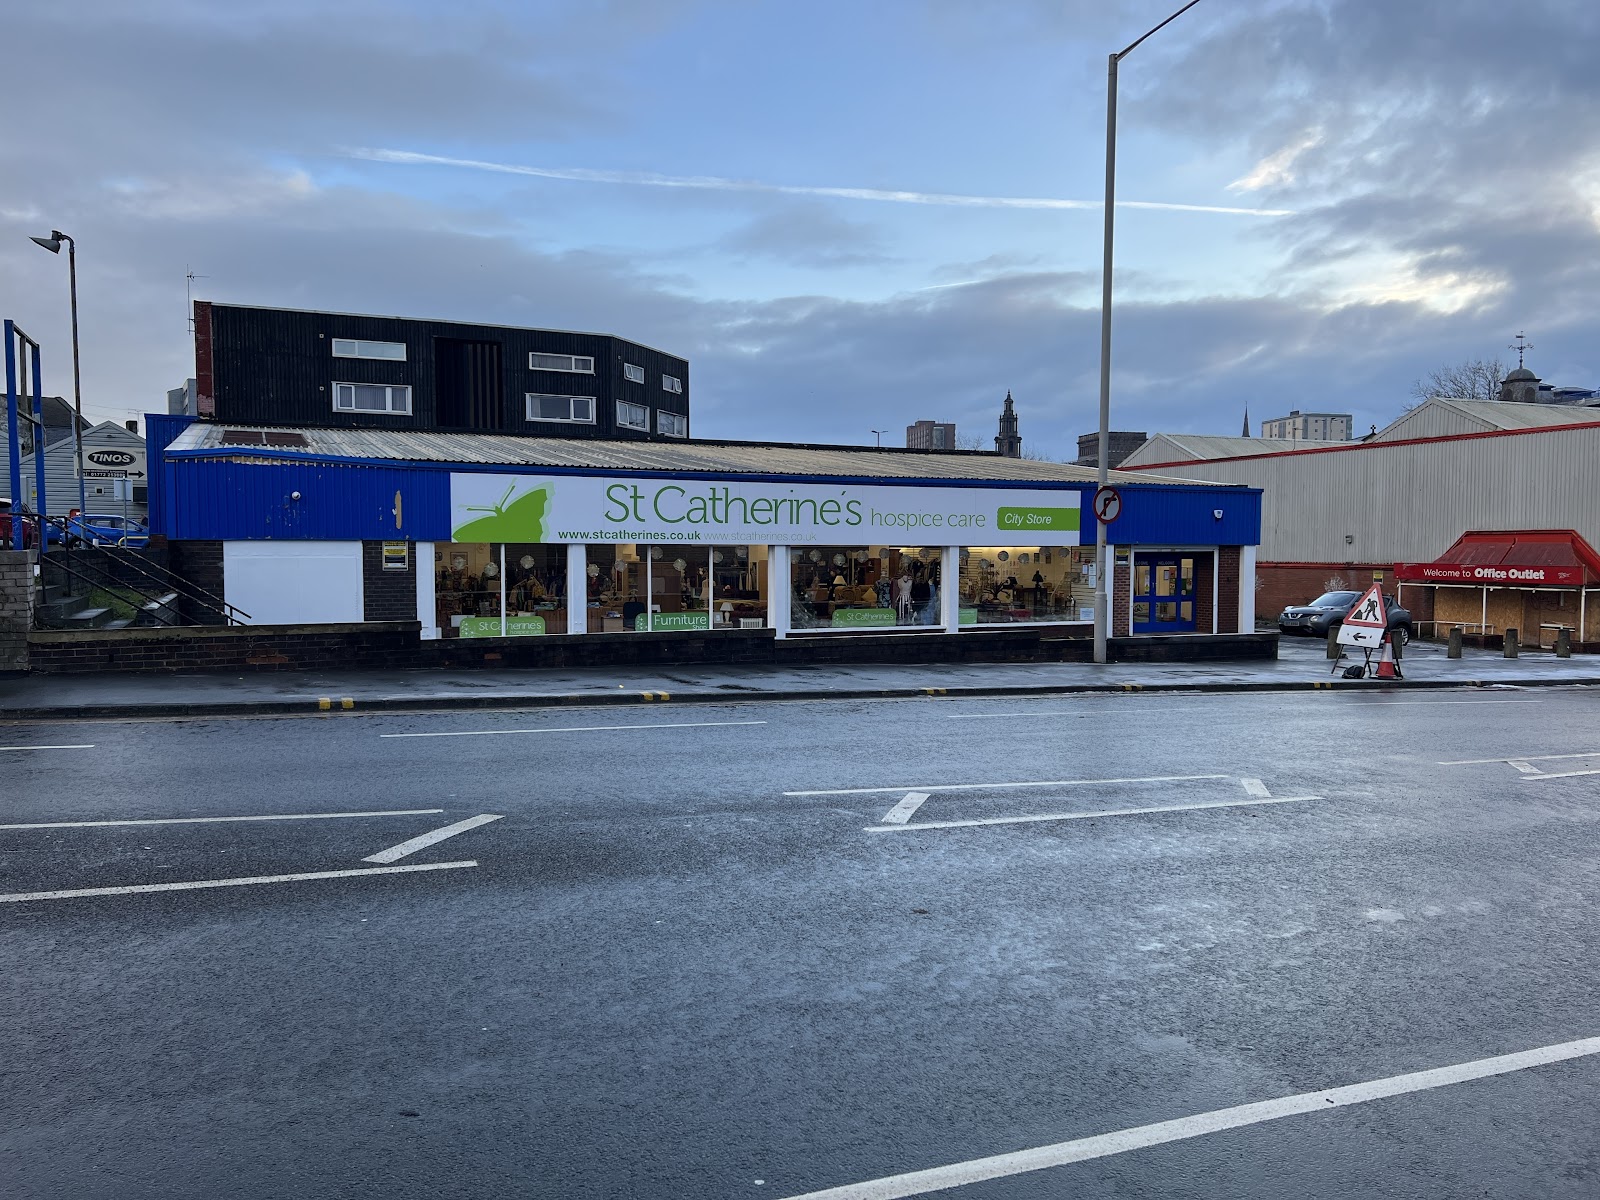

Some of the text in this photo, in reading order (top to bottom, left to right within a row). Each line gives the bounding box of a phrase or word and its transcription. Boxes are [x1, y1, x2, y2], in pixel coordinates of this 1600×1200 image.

[92, 453, 130, 462] TINOS
[604, 483, 986, 532] St Catherine's hospice care
[1004, 513, 1052, 526] City Store
[558, 529, 701, 541] www.stcatherines.co.uk
[704, 531, 817, 542] www.stcatherines.co.uk
[1423, 567, 1545, 580] Welcome to Office Outlet
[478, 621, 489, 631] St
[654, 614, 707, 626] Furniture
